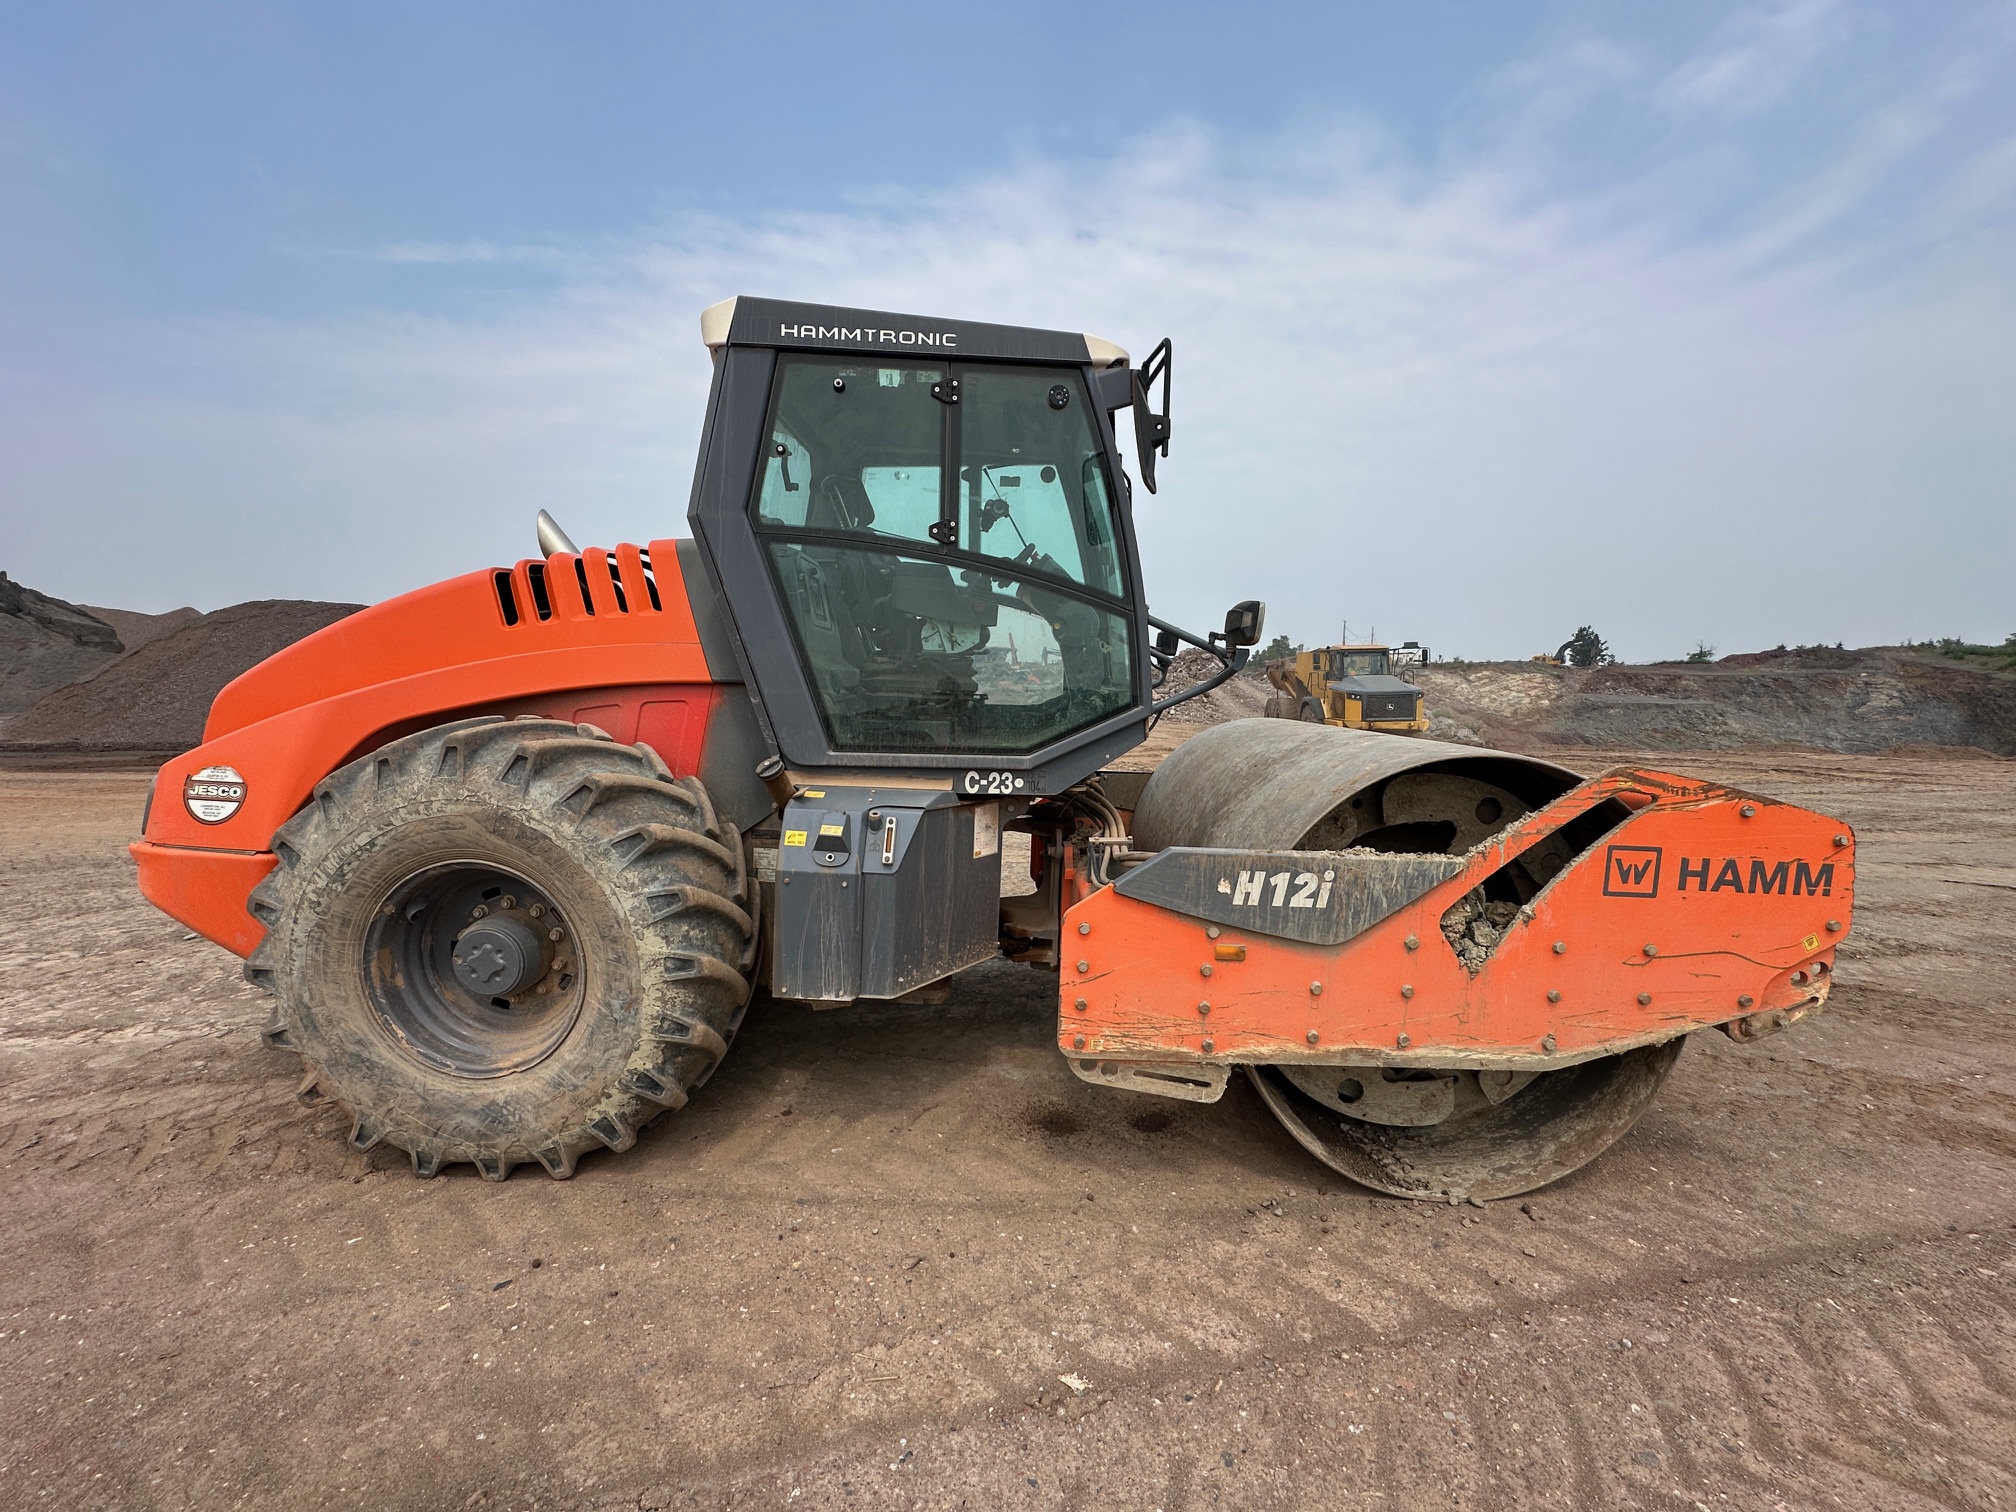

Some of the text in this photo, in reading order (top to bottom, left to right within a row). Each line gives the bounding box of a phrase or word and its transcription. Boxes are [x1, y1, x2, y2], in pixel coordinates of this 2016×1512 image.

[780, 323, 958, 347] HAMMTRONIC
[188, 784, 242, 798] JESCO
[964, 770, 1014, 795] C-23
[1232, 869, 1335, 908] H12i
[1677, 856, 1835, 897] HAMM
